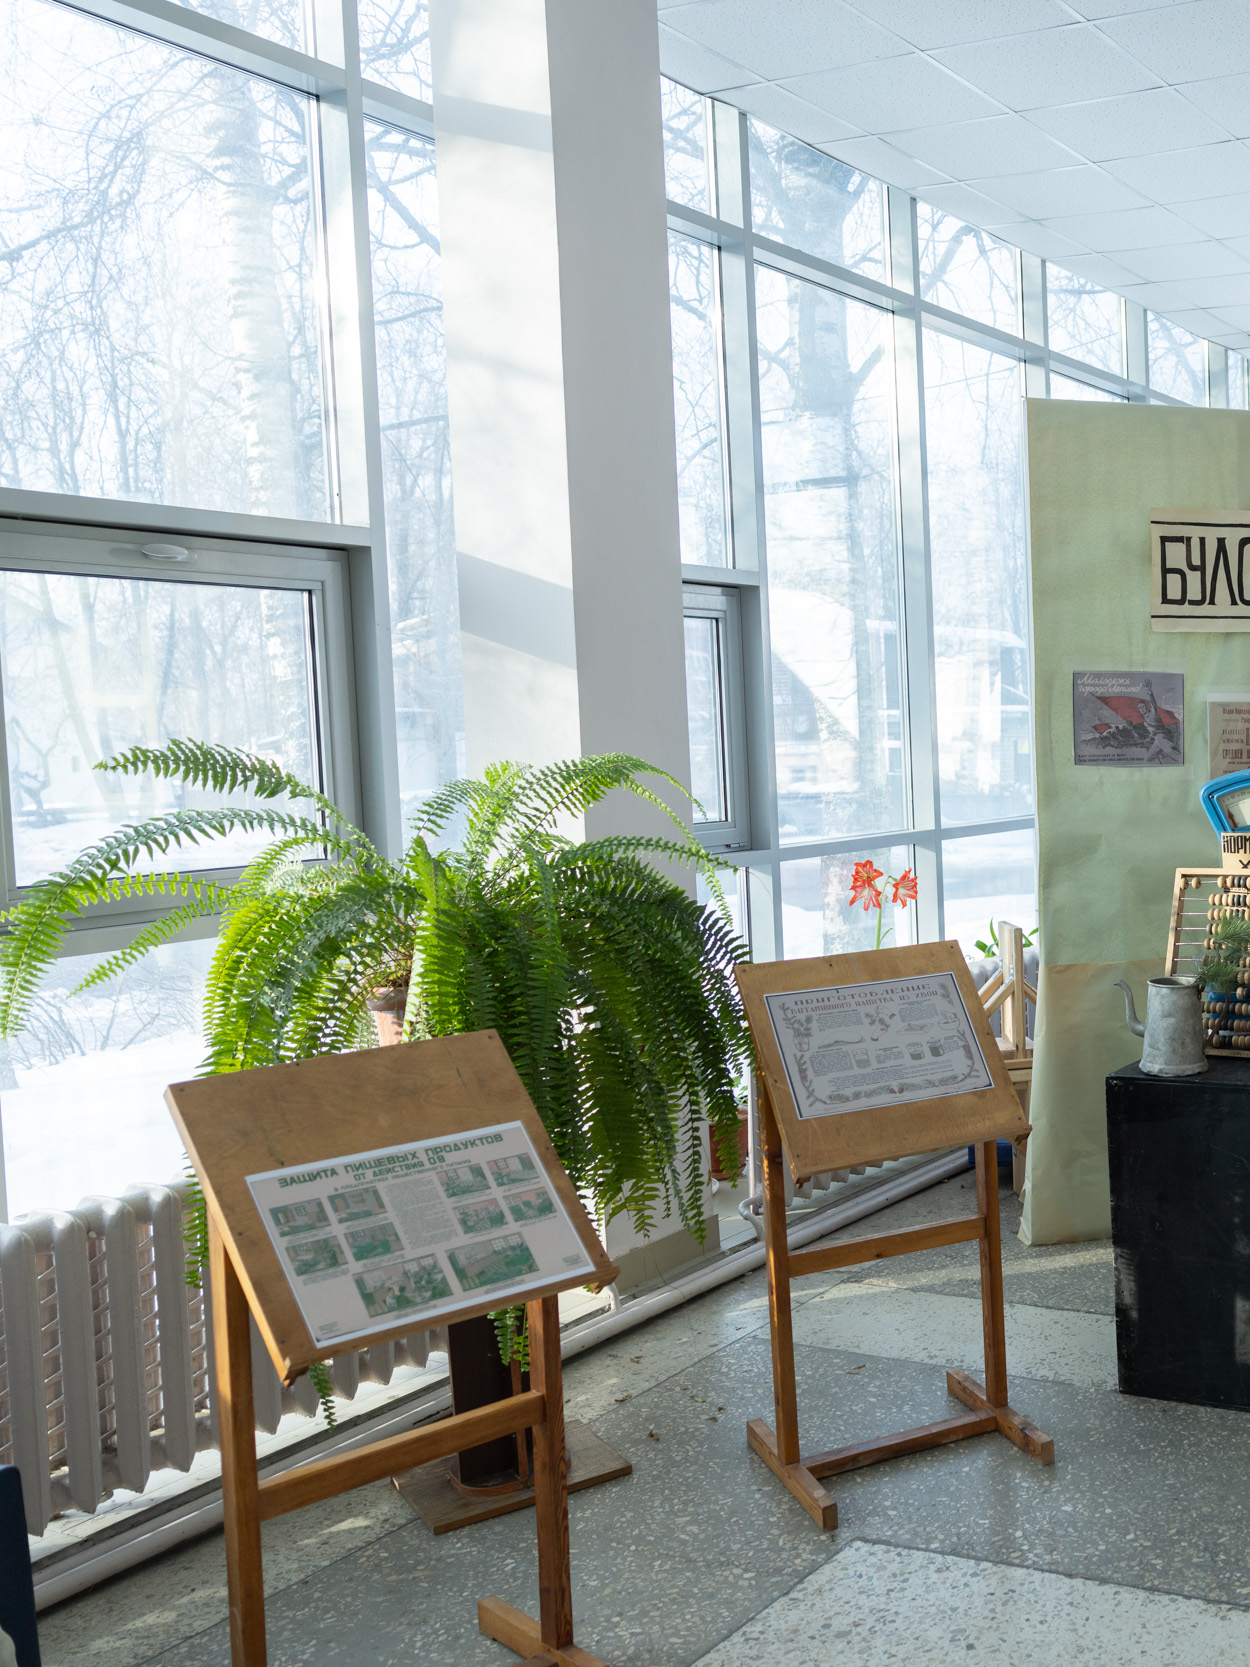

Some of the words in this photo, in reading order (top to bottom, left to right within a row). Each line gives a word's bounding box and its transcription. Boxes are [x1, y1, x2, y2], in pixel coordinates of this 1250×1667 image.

[1078, 672, 1130, 685] Молодежь
[1079, 685, 1107, 696] города
[794, 983, 931, 1007] ПРИГОТОВЛЕНИЕ
[855, 997, 895, 1008] НАПИТКА
[915, 989, 939, 999] ХВОИ
[277, 1167, 339, 1189] ЗАЩИТА
[424, 1133, 504, 1157] ПРОДУКТОВ
[353, 1171, 368, 1182] ОТ
[372, 1160, 425, 1178] ДЕЙСТВИЯ
